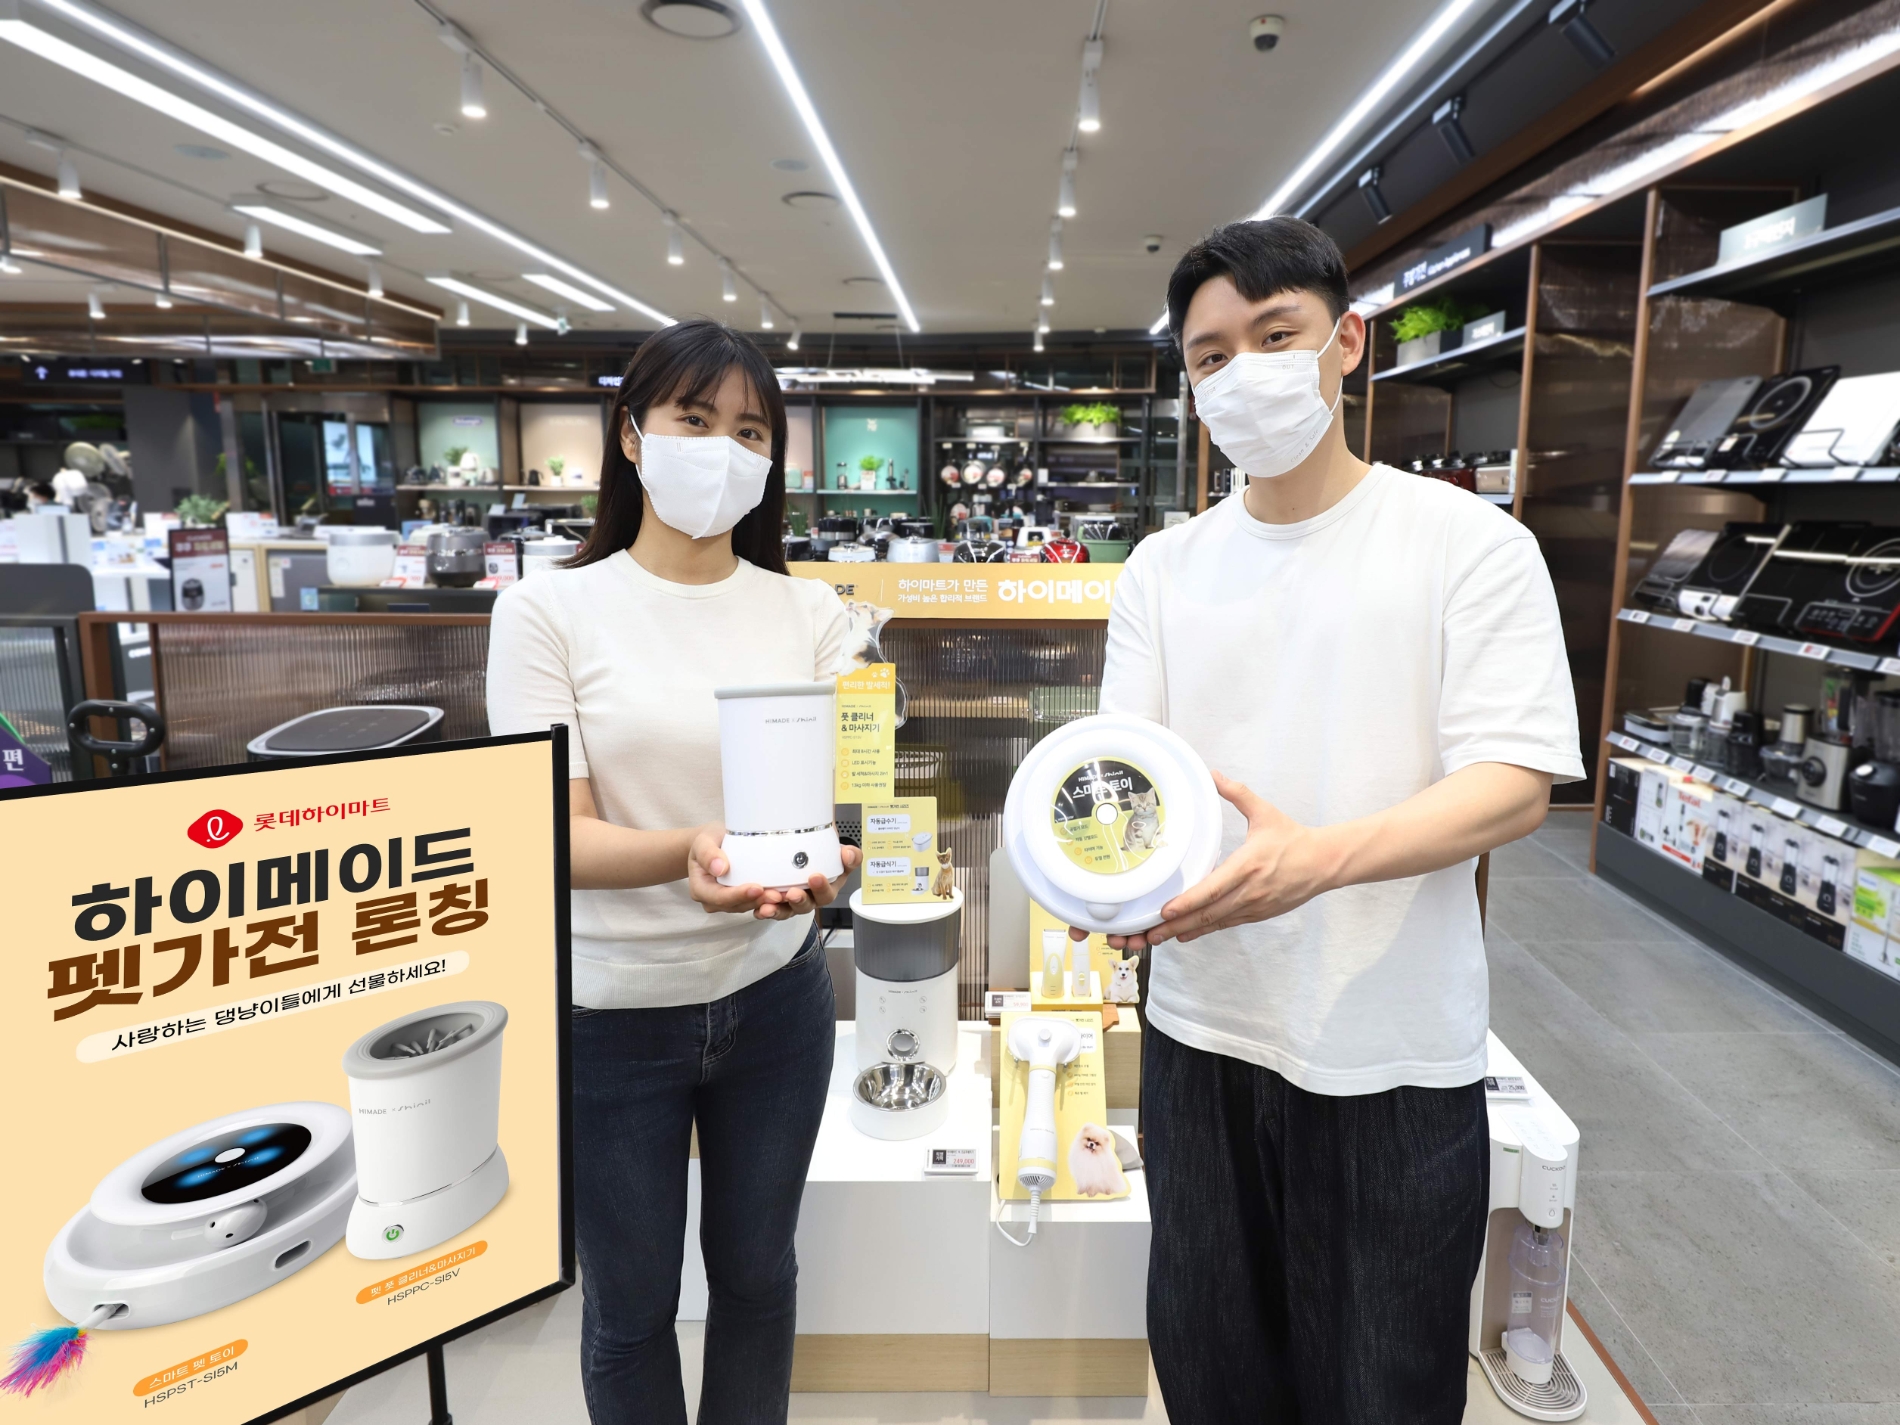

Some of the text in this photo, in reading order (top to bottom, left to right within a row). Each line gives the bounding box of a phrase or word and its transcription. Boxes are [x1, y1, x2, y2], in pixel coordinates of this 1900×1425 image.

[897, 593, 988, 604] 가성비 높은 합리적 브랜드
[898, 578, 989, 594] 하이마트가 만든
[997, 578, 1117, 605] 하이메이
[842, 680, 865, 690] 편리한
[841, 724, 880, 732] & 마사지기
[850, 712, 874, 722] 클리너
[2, 748, 25, 772] 편
[253, 797, 391, 832] 롯데하이마트
[71, 827, 476, 943] 하이메이드
[47, 878, 490, 1023] 펫가전 론칭
[111, 959, 448, 1052] 사랑하는 댕냥이들에게 선물하세요!
[359, 1107, 388, 1115] HIMADE
[370, 1285, 382, 1298] 펫
[397, 1246, 477, 1287] 클리너&마사지기
[387, 1267, 461, 1306] HSPPC-SI5V
[149, 1346, 235, 1389] 스마트 펫 토이
[144, 1361, 239, 1409] HSPST-SI5M
